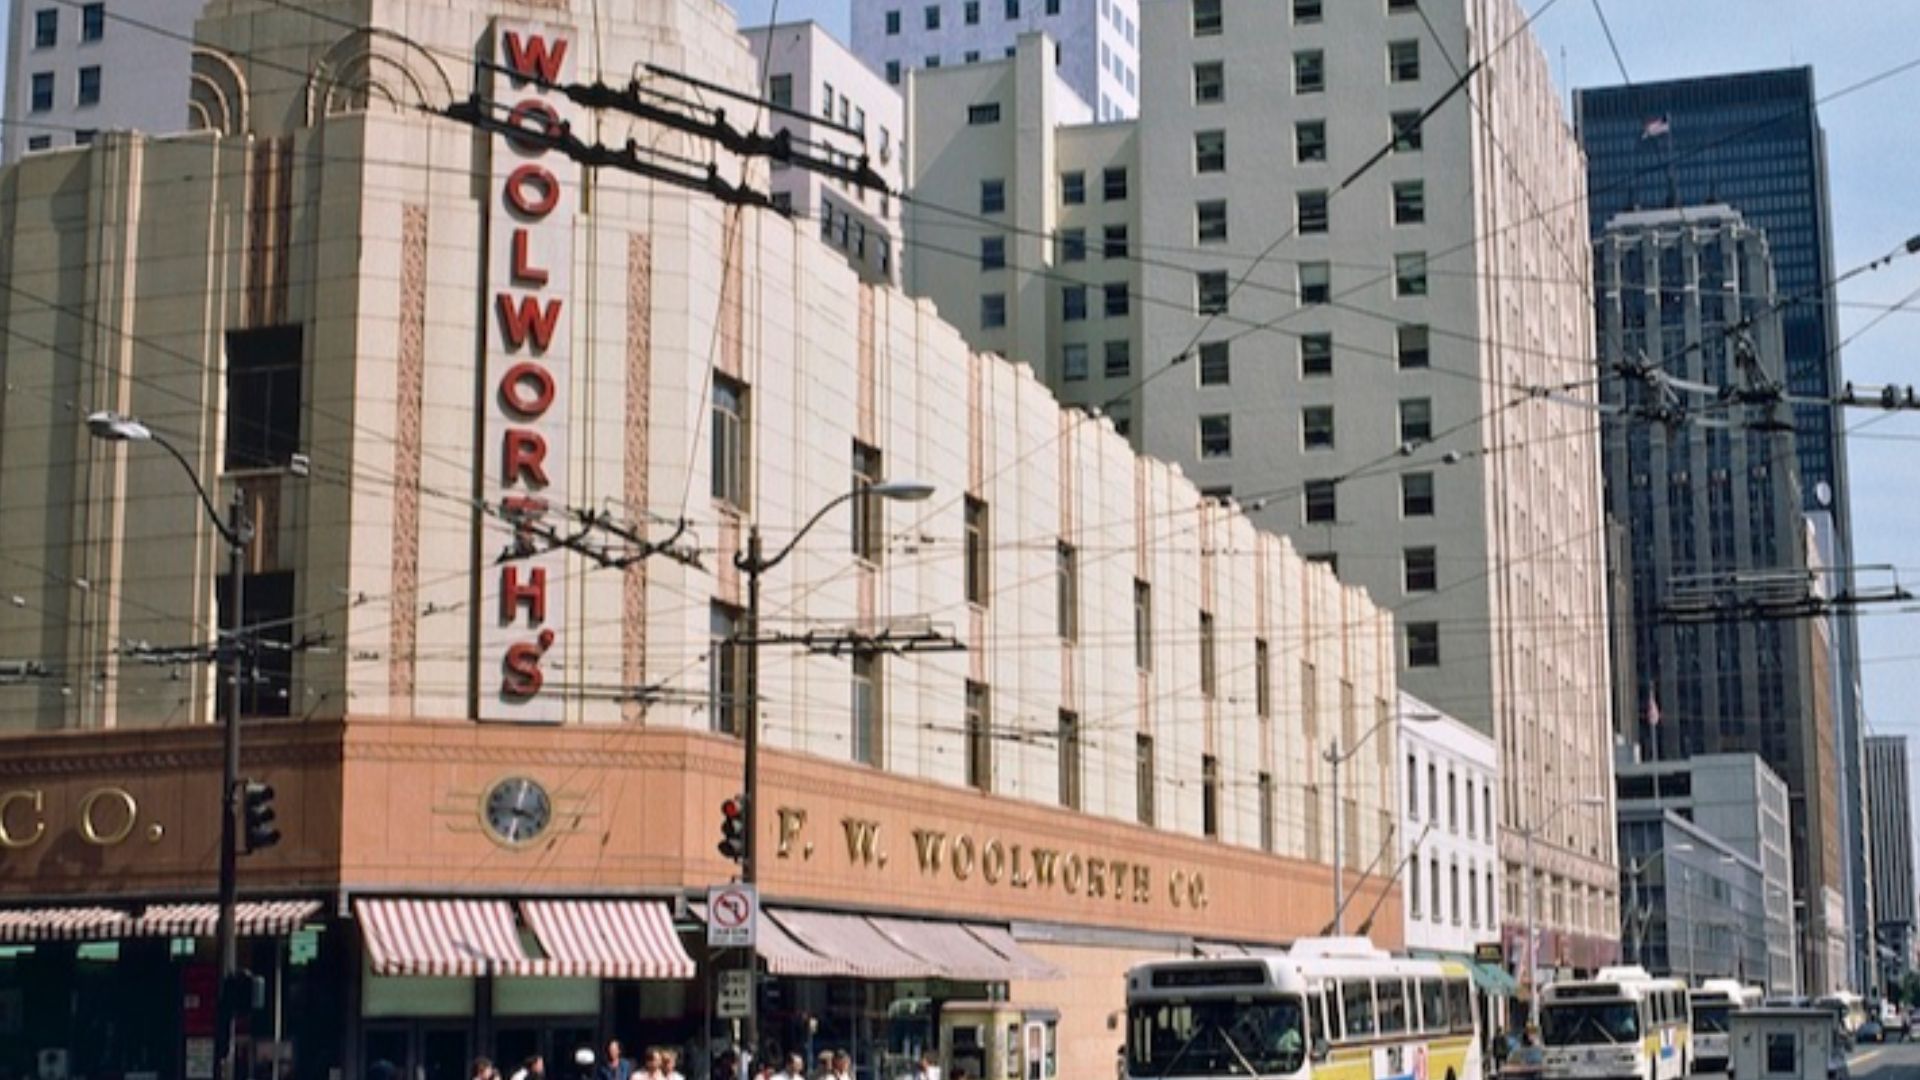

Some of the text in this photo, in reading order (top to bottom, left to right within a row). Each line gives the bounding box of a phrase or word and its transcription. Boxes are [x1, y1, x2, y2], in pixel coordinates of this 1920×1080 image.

[497, 31, 567, 695] WOOLWORTH'S
[777, 807, 1208, 909] F. W. WOOLWORTH CO.
